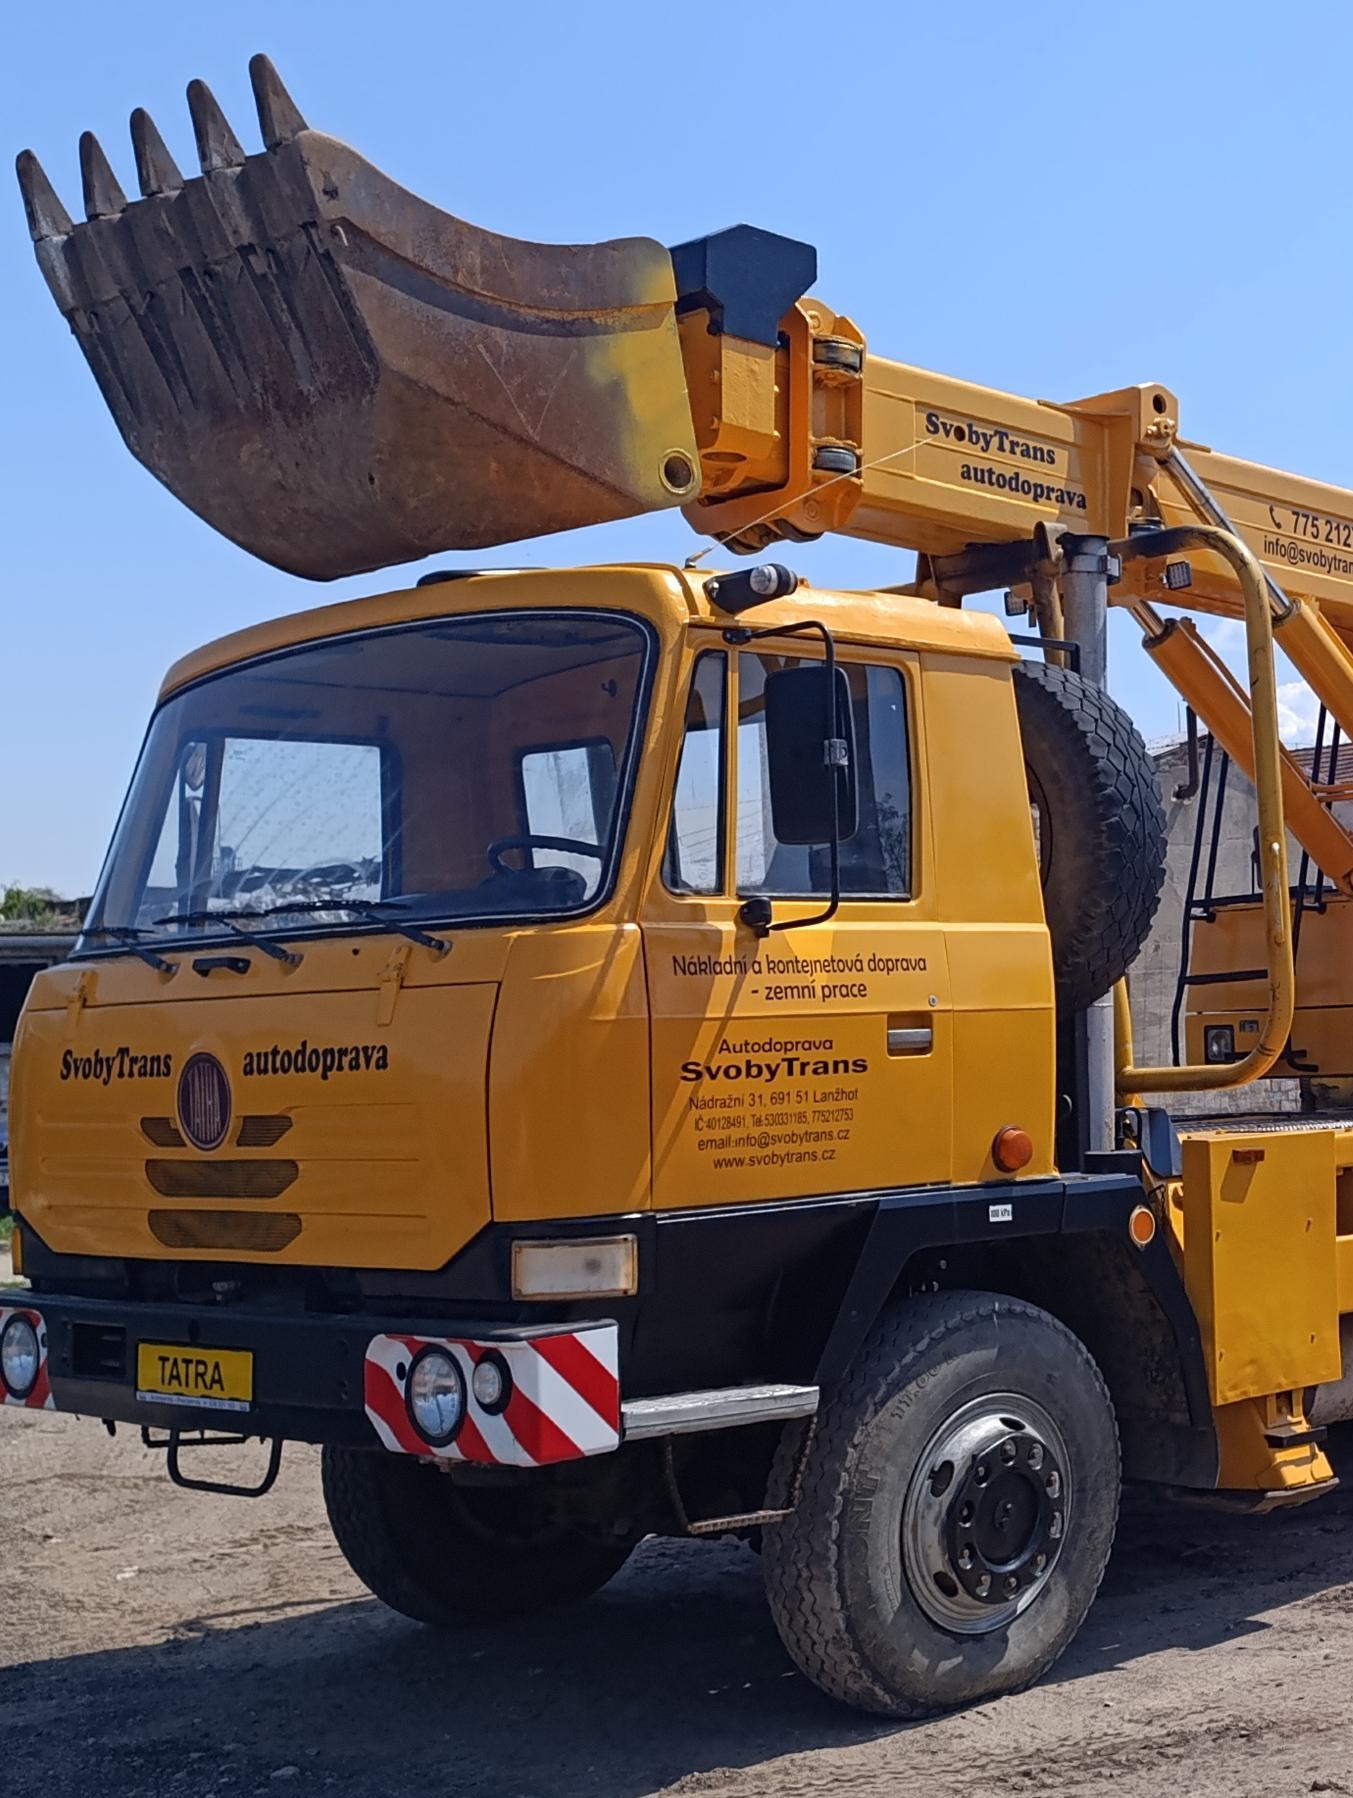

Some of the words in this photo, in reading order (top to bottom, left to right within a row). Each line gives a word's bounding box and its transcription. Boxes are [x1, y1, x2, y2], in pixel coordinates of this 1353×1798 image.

[925, 412, 1056, 465] SvobyTrans
[960, 463, 1087, 510] autodoprava
[1291, 510, 1320, 540] 775
[672, 954, 747, 977] Nákladní
[752, 963, 762, 975] a
[867, 953, 927, 975] doprava
[764, 980, 816, 1000] zemní
[822, 982, 868, 1002] prace
[718, 1038, 834, 1055] Autodoprava
[60, 1047, 172, 1086] SvobyTrans
[243, 1040, 389, 1081] autodoprava
[680, 1057, 869, 1082] SvobyTrans
[770, 1091, 791, 1106] 691
[796, 1090, 809, 1104] 51
[713, 1149, 836, 1170] www.svobytrans.cz
[158, 1355, 225, 1391] TATRA
